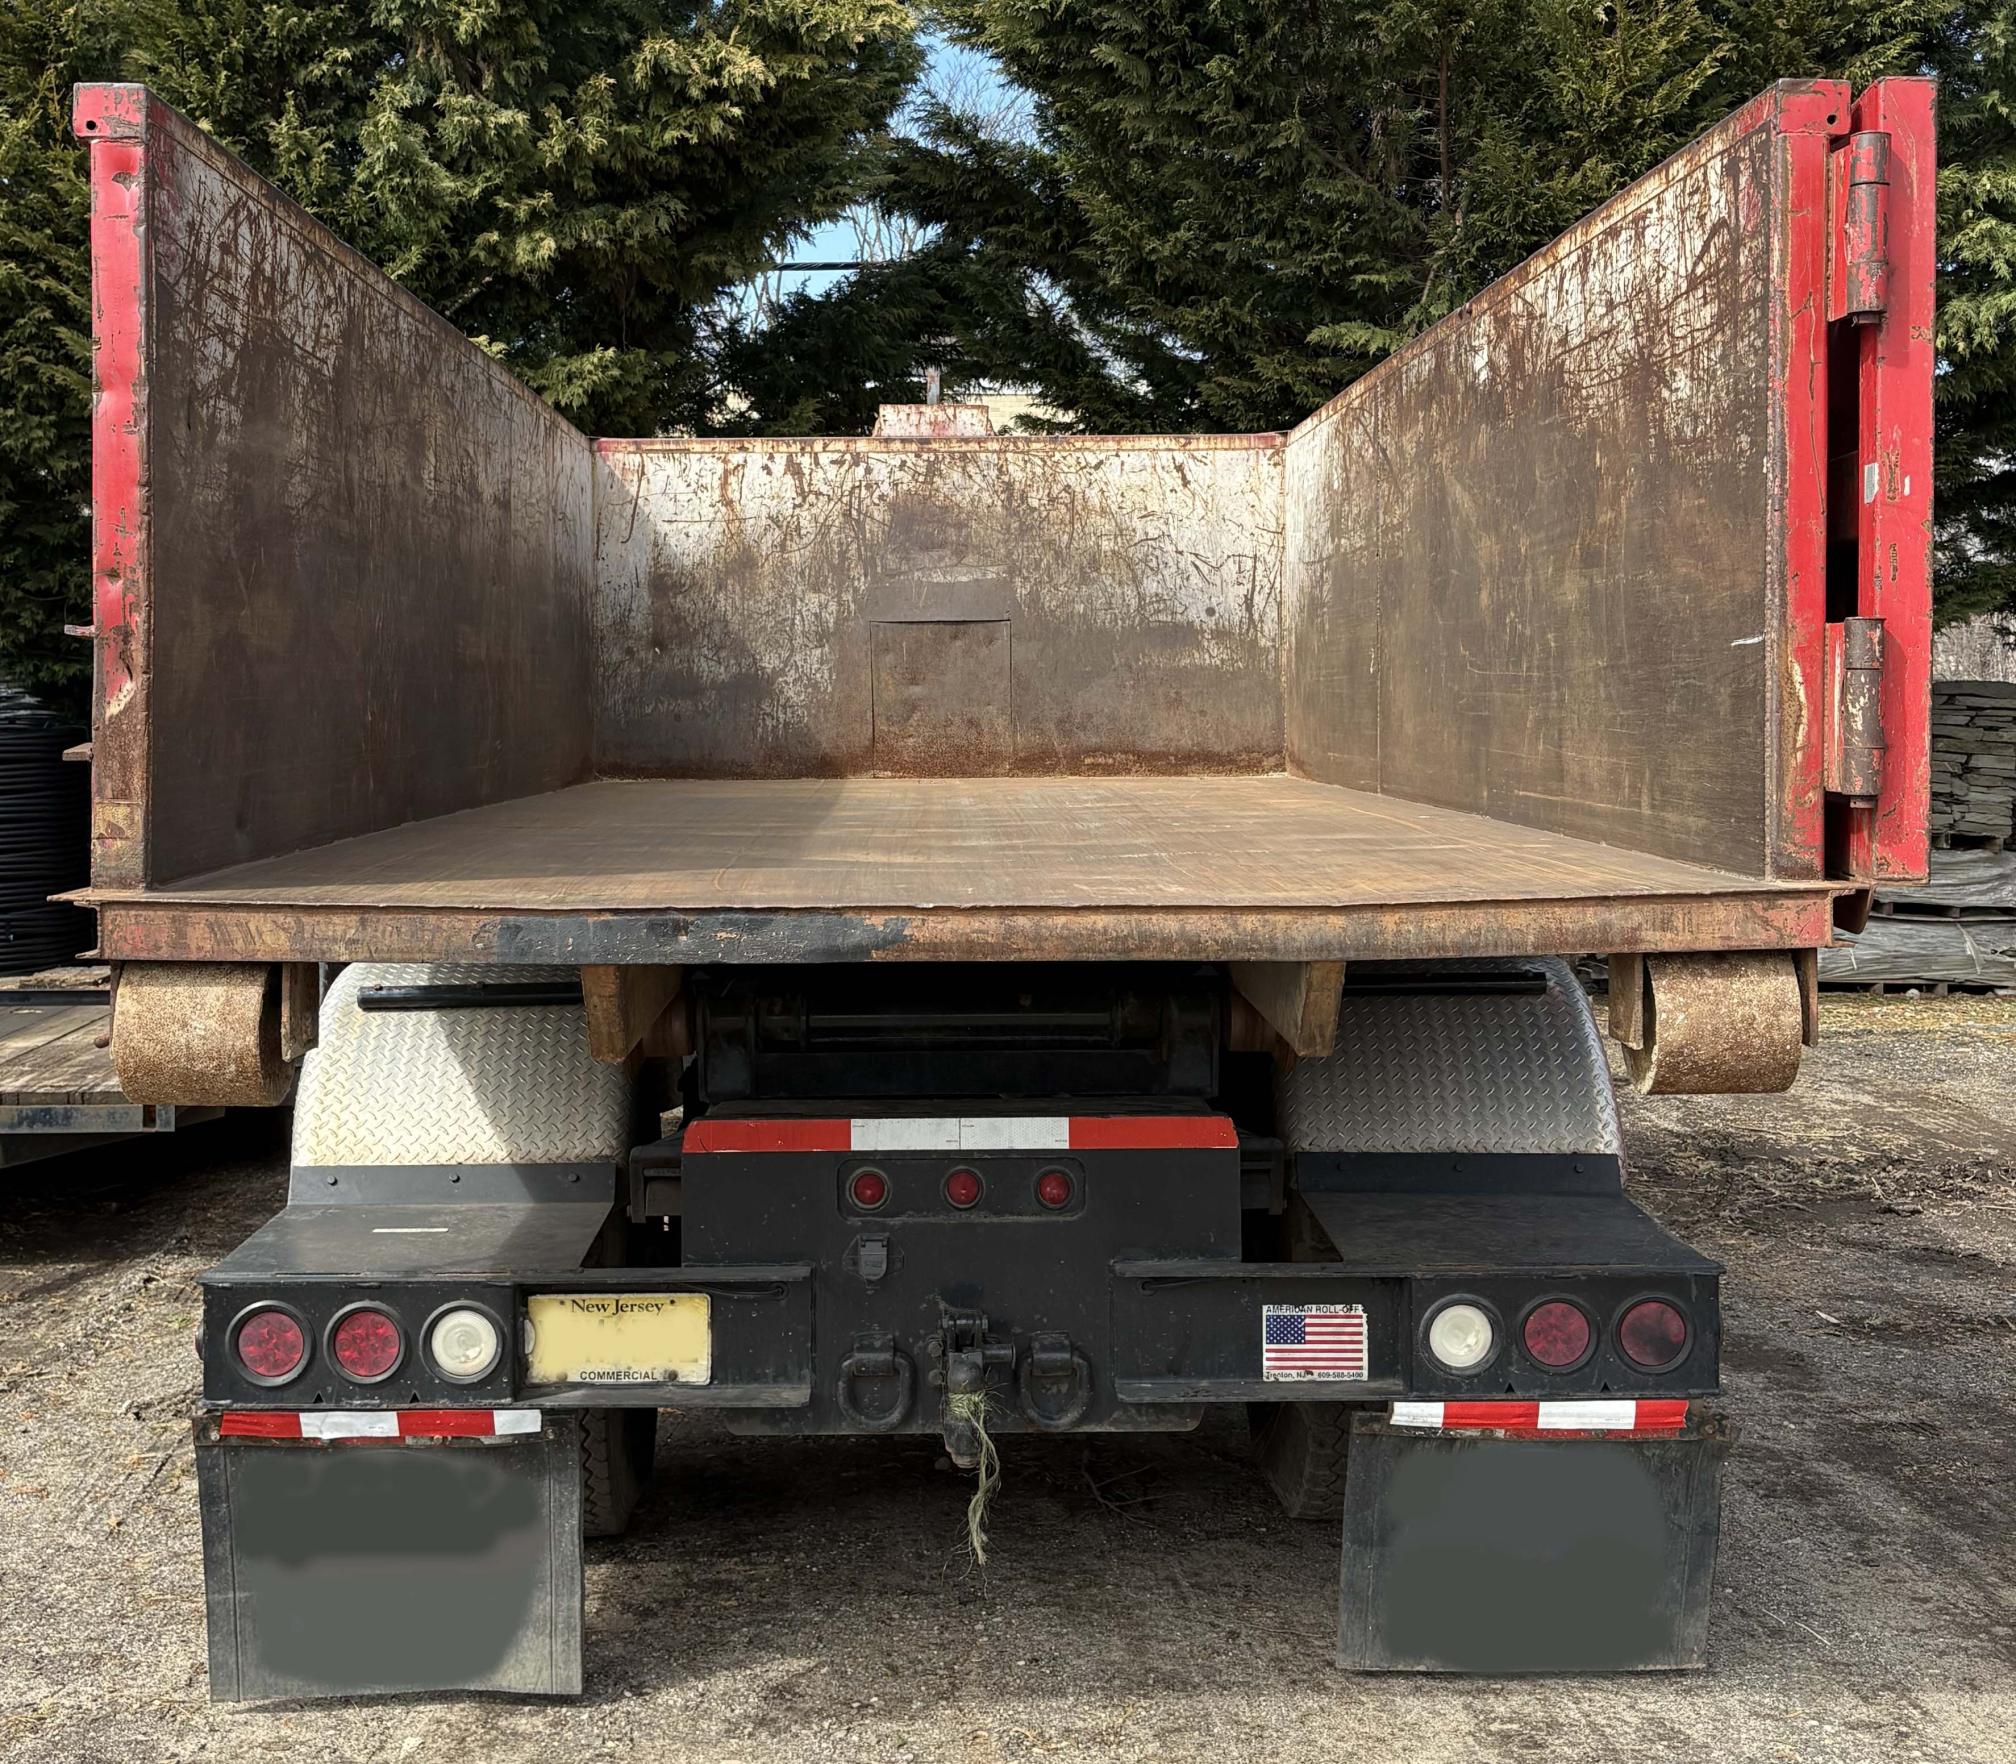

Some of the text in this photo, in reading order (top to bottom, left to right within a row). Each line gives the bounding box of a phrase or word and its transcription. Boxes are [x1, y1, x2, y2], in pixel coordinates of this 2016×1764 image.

[571, 1299, 664, 1316] New Jersey
[580, 1371, 657, 1380] COMMERCIAL
